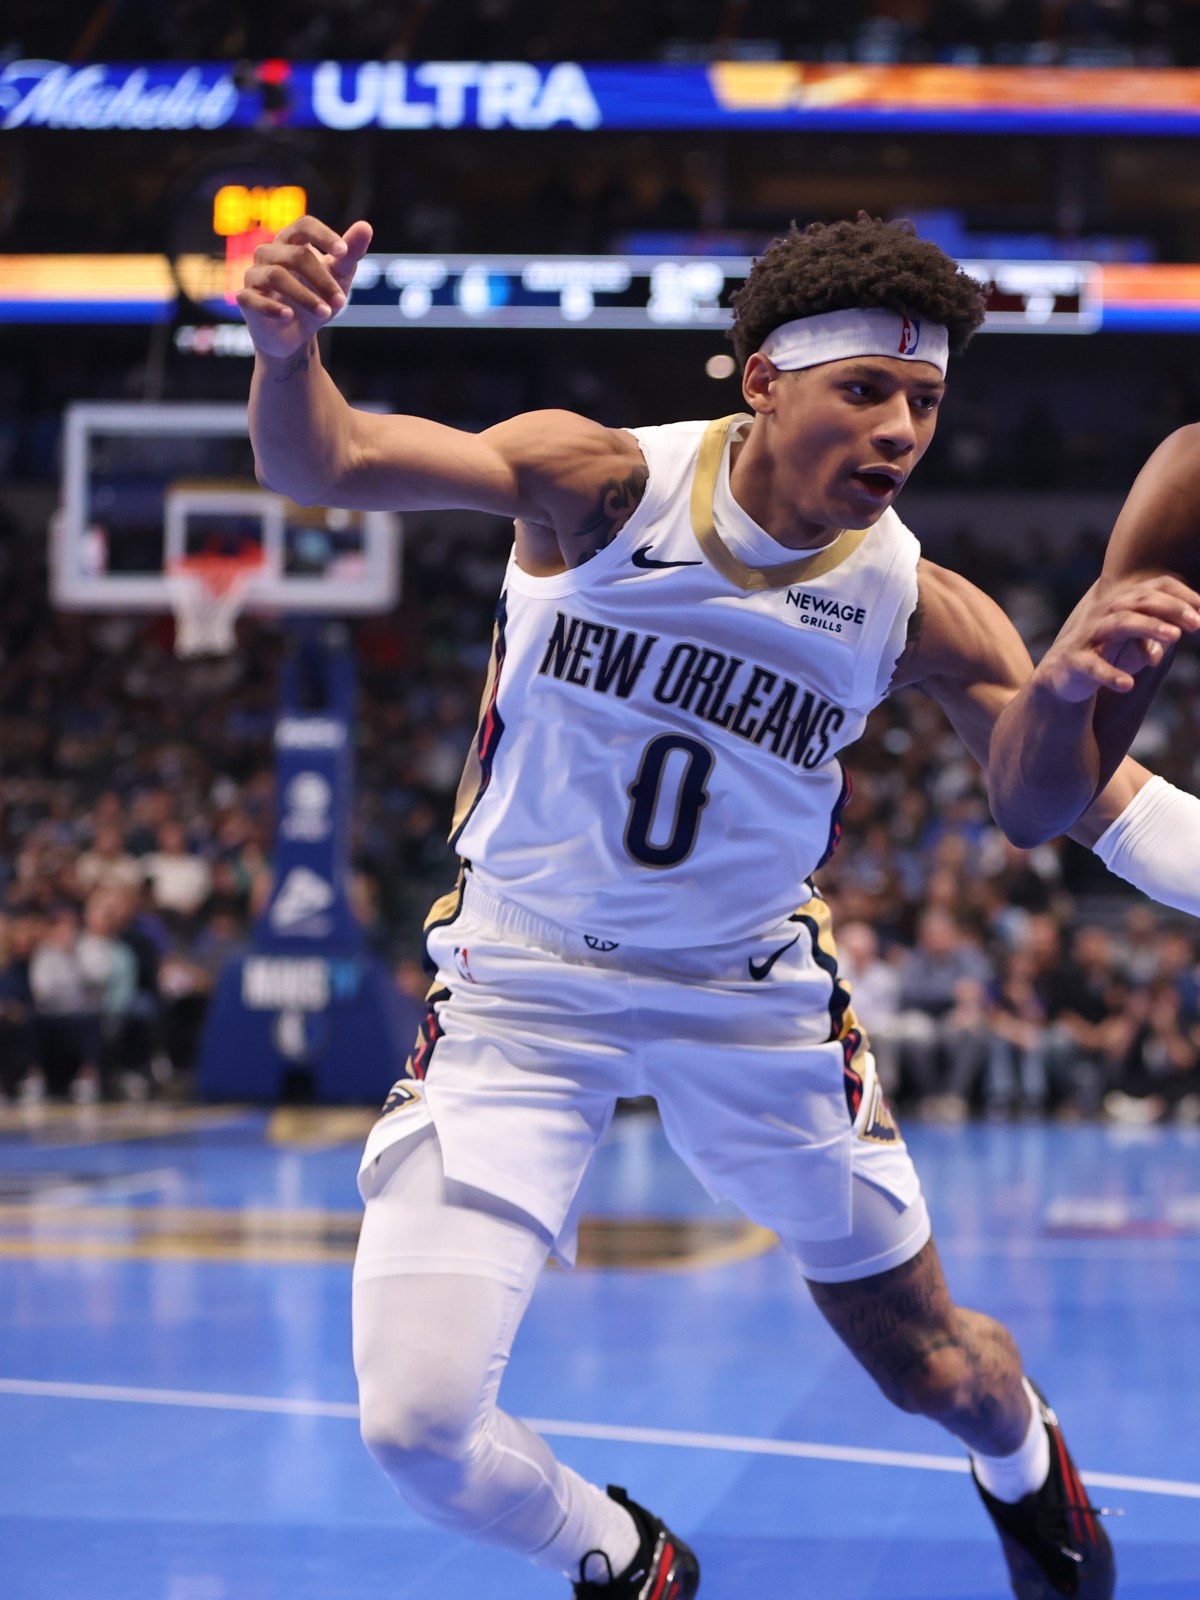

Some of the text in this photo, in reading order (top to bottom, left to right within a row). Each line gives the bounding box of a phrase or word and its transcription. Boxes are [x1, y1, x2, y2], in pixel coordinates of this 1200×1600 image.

[311, 60, 601, 130] ULTRA
[786, 589, 866, 625] NEWAGE
[800, 614, 842, 633] GRILLS
[539, 612, 845, 770] NEW ORLEANS
[624, 732, 716, 869] 0
